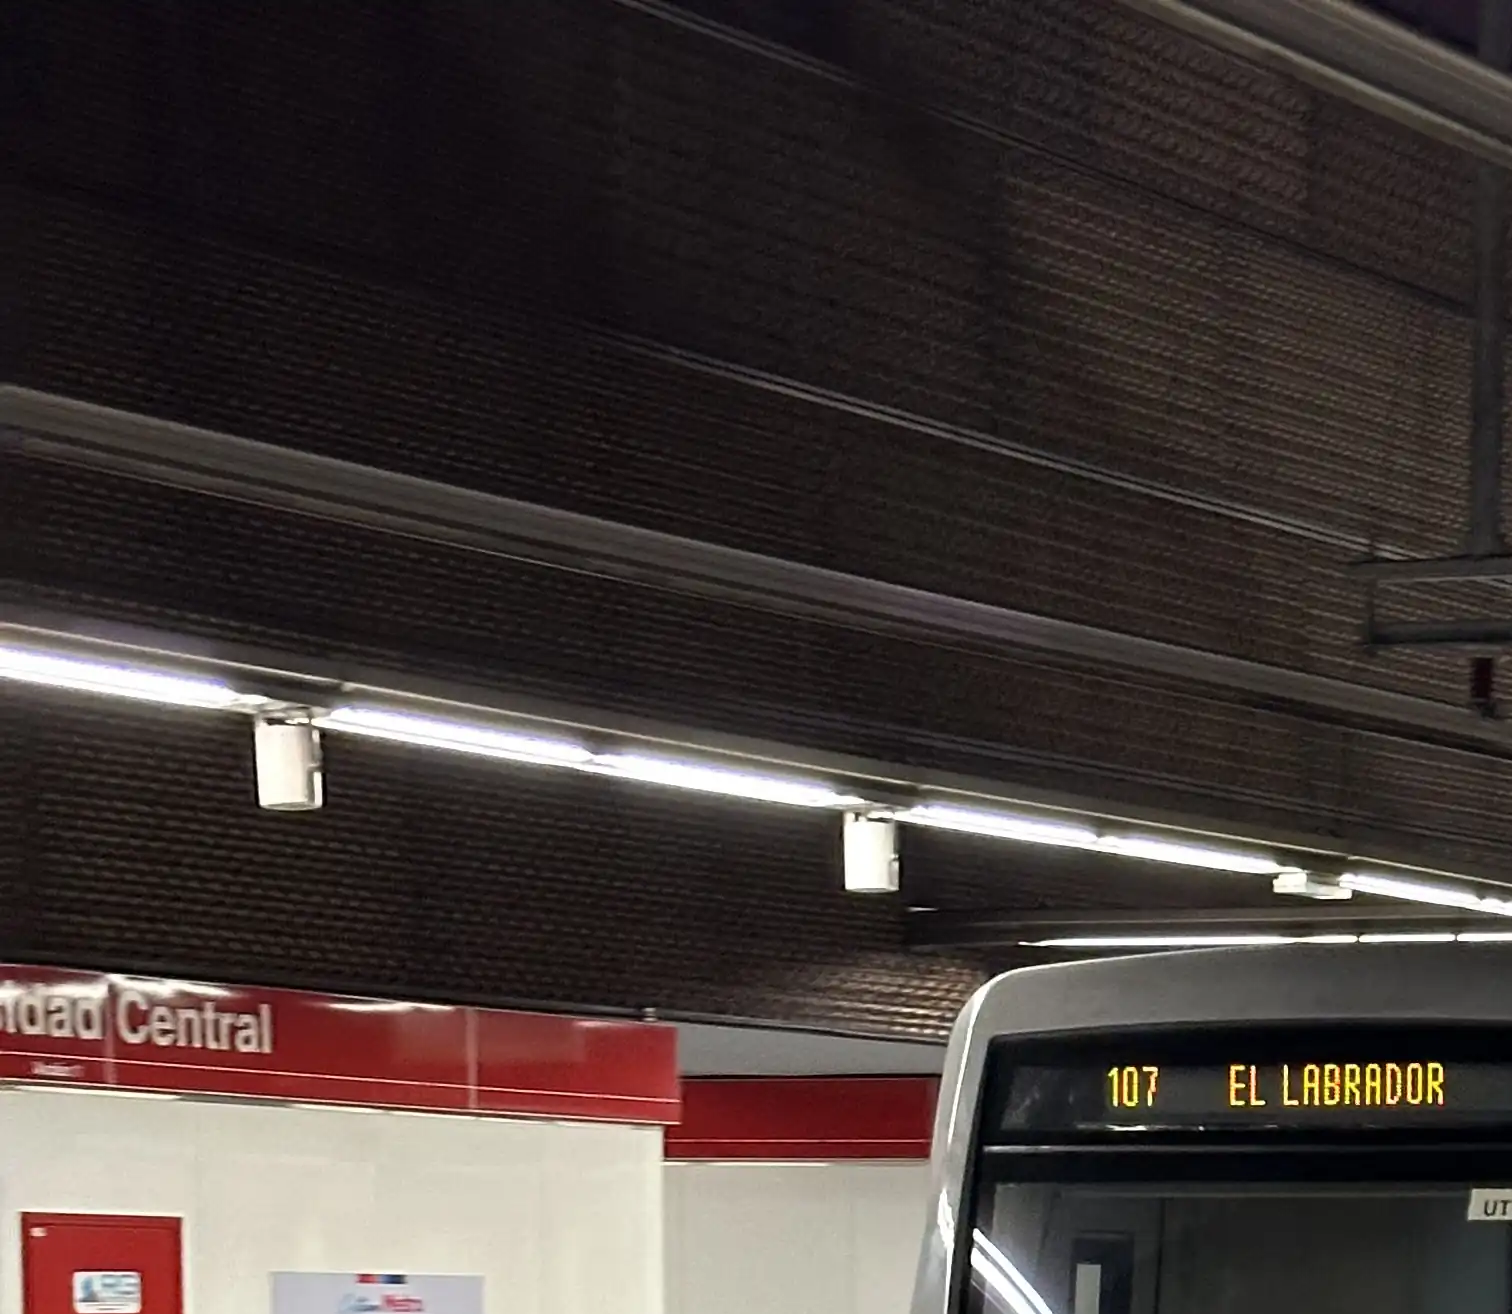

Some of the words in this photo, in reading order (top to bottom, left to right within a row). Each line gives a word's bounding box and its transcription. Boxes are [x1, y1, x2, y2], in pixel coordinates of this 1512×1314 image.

[115, 988, 273, 1054] Central
[1108, 1066, 1159, 1108] 107
[1229, 1064, 1266, 1107] EL
[1282, 1062, 1445, 1107] LABRADOR
